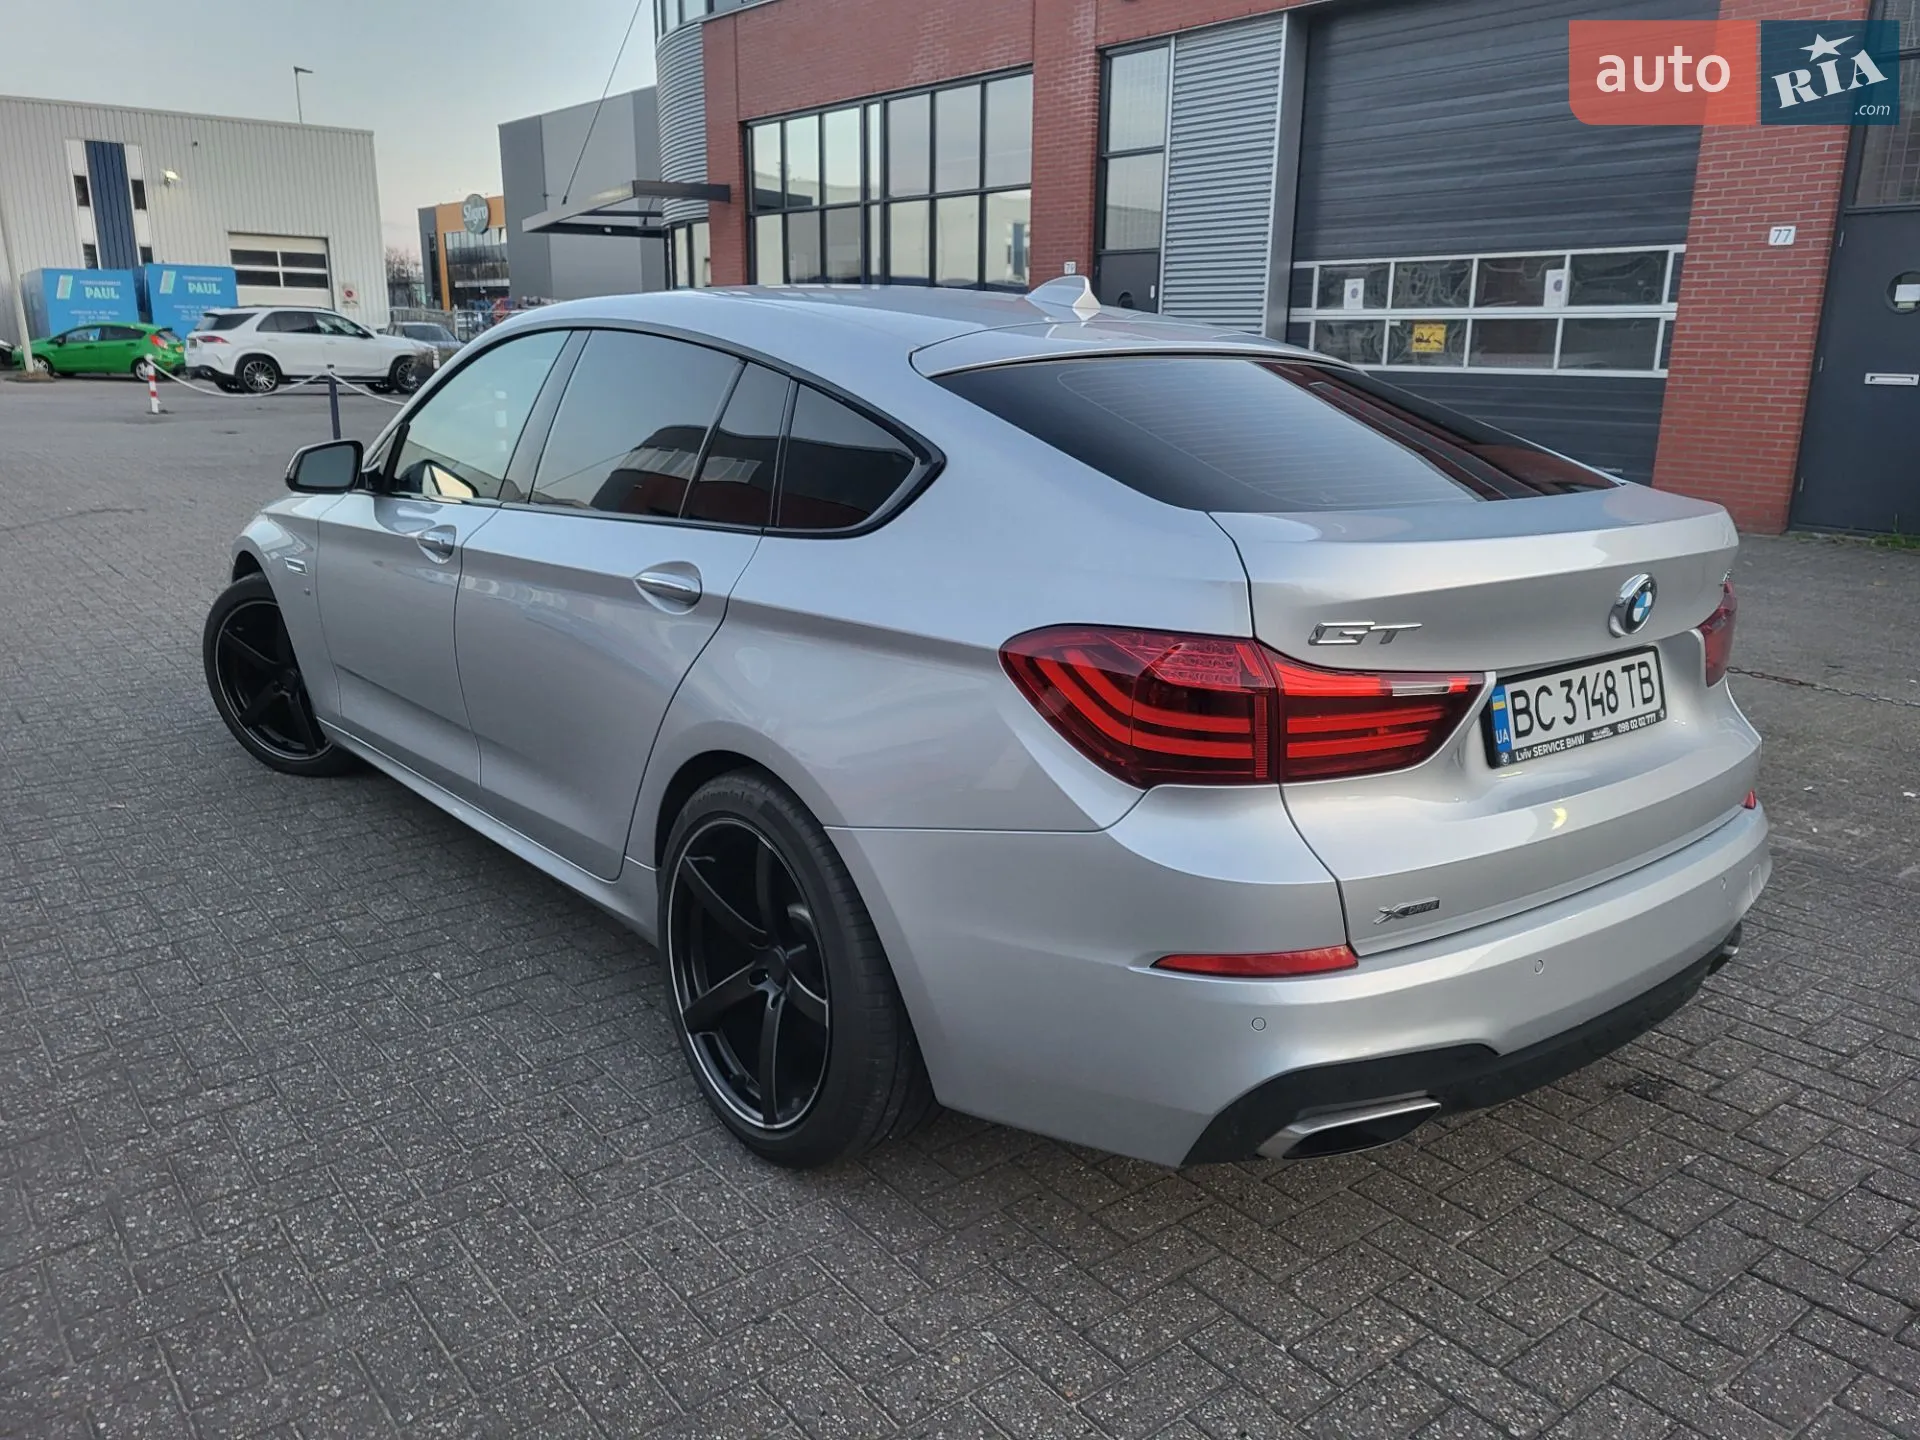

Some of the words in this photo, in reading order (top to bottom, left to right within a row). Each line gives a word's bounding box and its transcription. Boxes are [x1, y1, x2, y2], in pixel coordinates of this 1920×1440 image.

[1773, 228, 1792, 243] 77
[84, 286, 120, 299] PAUL
[188, 282, 221, 294] PAUL
[1308, 620, 1423, 647] GT
[1510, 684, 1556, 739] BC
[1559, 669, 1620, 725] 3148
[1621, 661, 1656, 709] TB
[1495, 728, 1510, 745] UA
[1532, 738, 1566, 756] SERVICE
[1566, 733, 1585, 749] BMW
